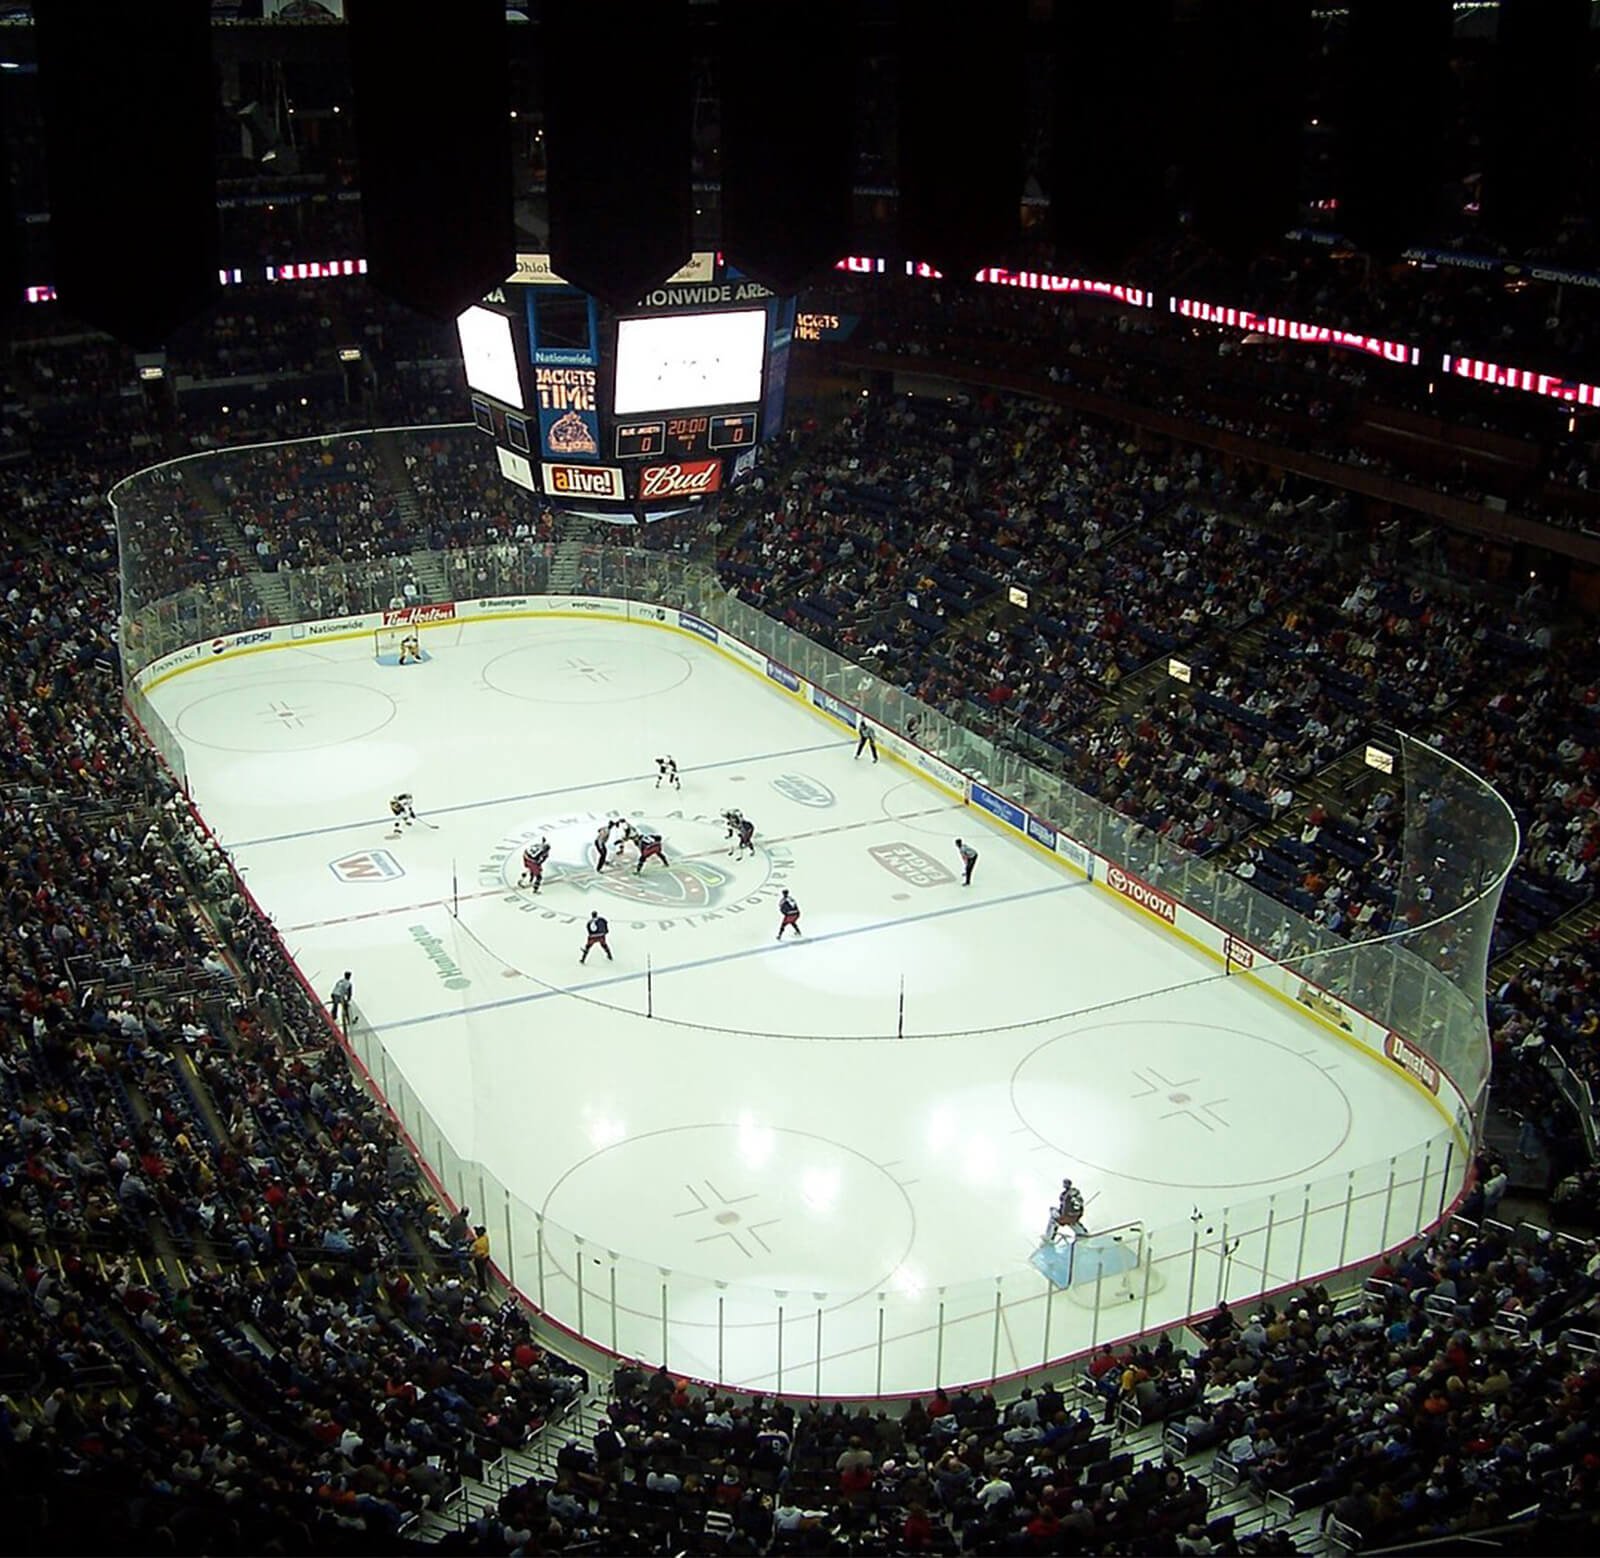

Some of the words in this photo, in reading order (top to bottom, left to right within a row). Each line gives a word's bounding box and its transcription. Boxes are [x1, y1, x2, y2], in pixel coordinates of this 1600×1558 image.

[1435, 254, 1493, 272] CHEVROLET
[638, 286, 732, 307] IONWIDE
[535, 352, 593, 364] Nationwide
[535, 368, 596, 386] JACKETS
[536, 384, 596, 411] TIME
[667, 417, 707, 435] 20:00
[733, 428, 744, 442] 0
[641, 437, 652, 452] 0
[555, 468, 613, 493] alive!
[643, 463, 717, 496] Bud
[309, 621, 364, 635] Nationwide
[235, 631, 272, 647] PEPSI
[1127, 880, 1175, 921] TOYOTA
